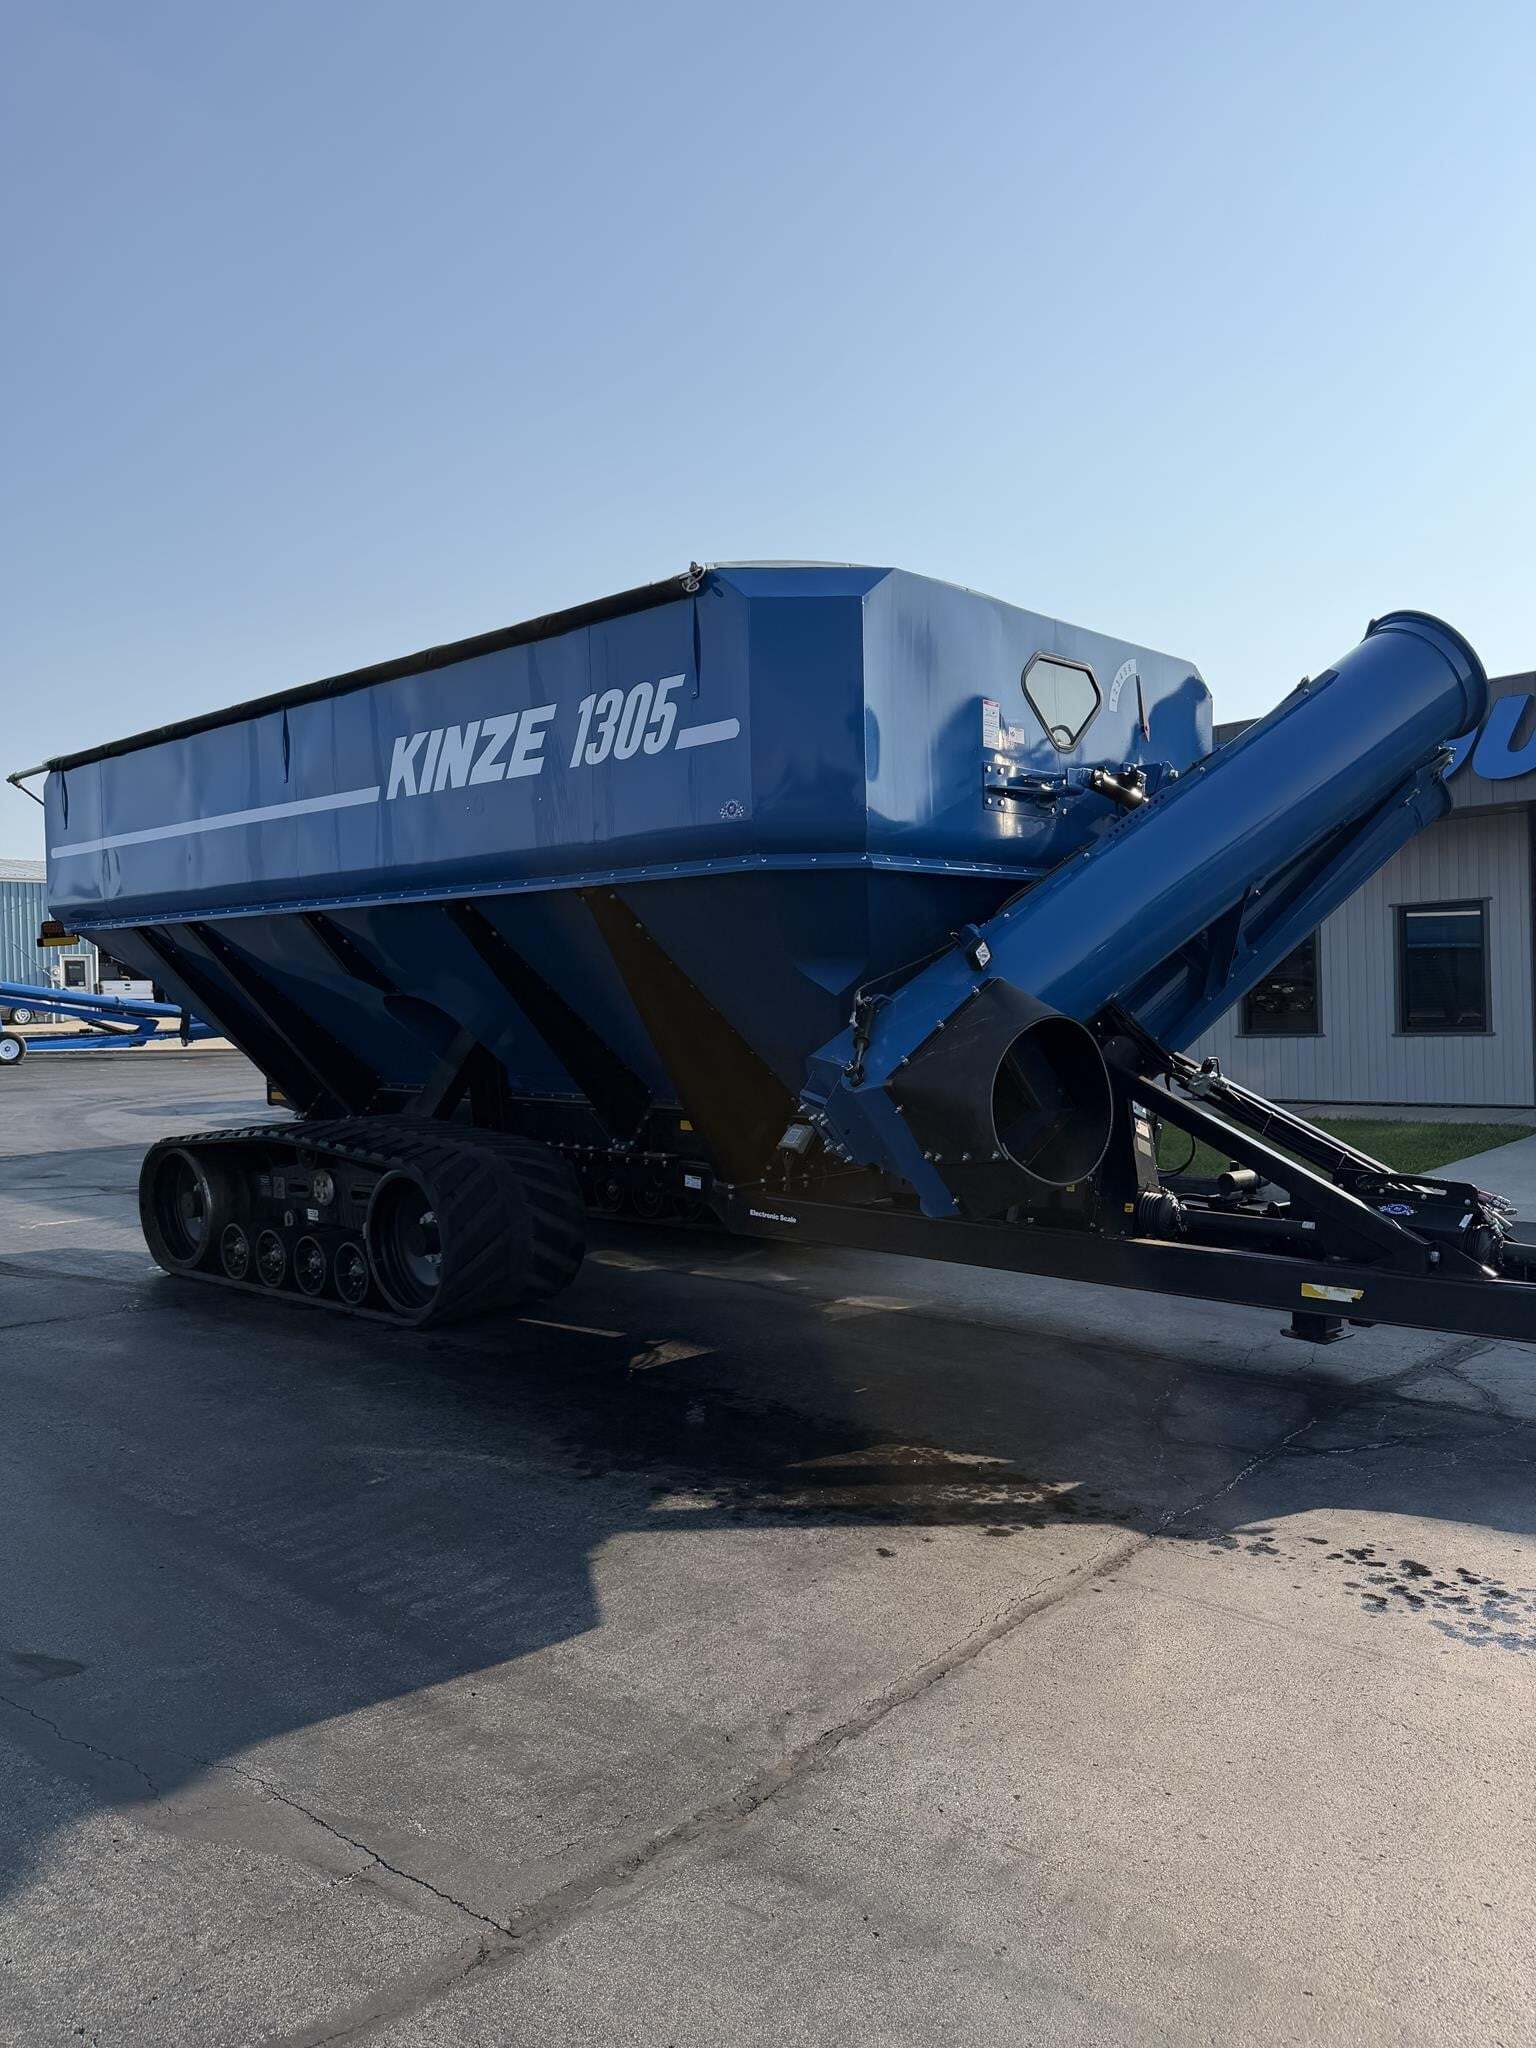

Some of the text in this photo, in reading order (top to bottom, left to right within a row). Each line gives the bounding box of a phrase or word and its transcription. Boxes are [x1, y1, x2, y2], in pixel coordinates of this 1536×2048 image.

[386, 673, 686, 800] KINZE 1305
[749, 1208, 797, 1223] Electronic Scale
